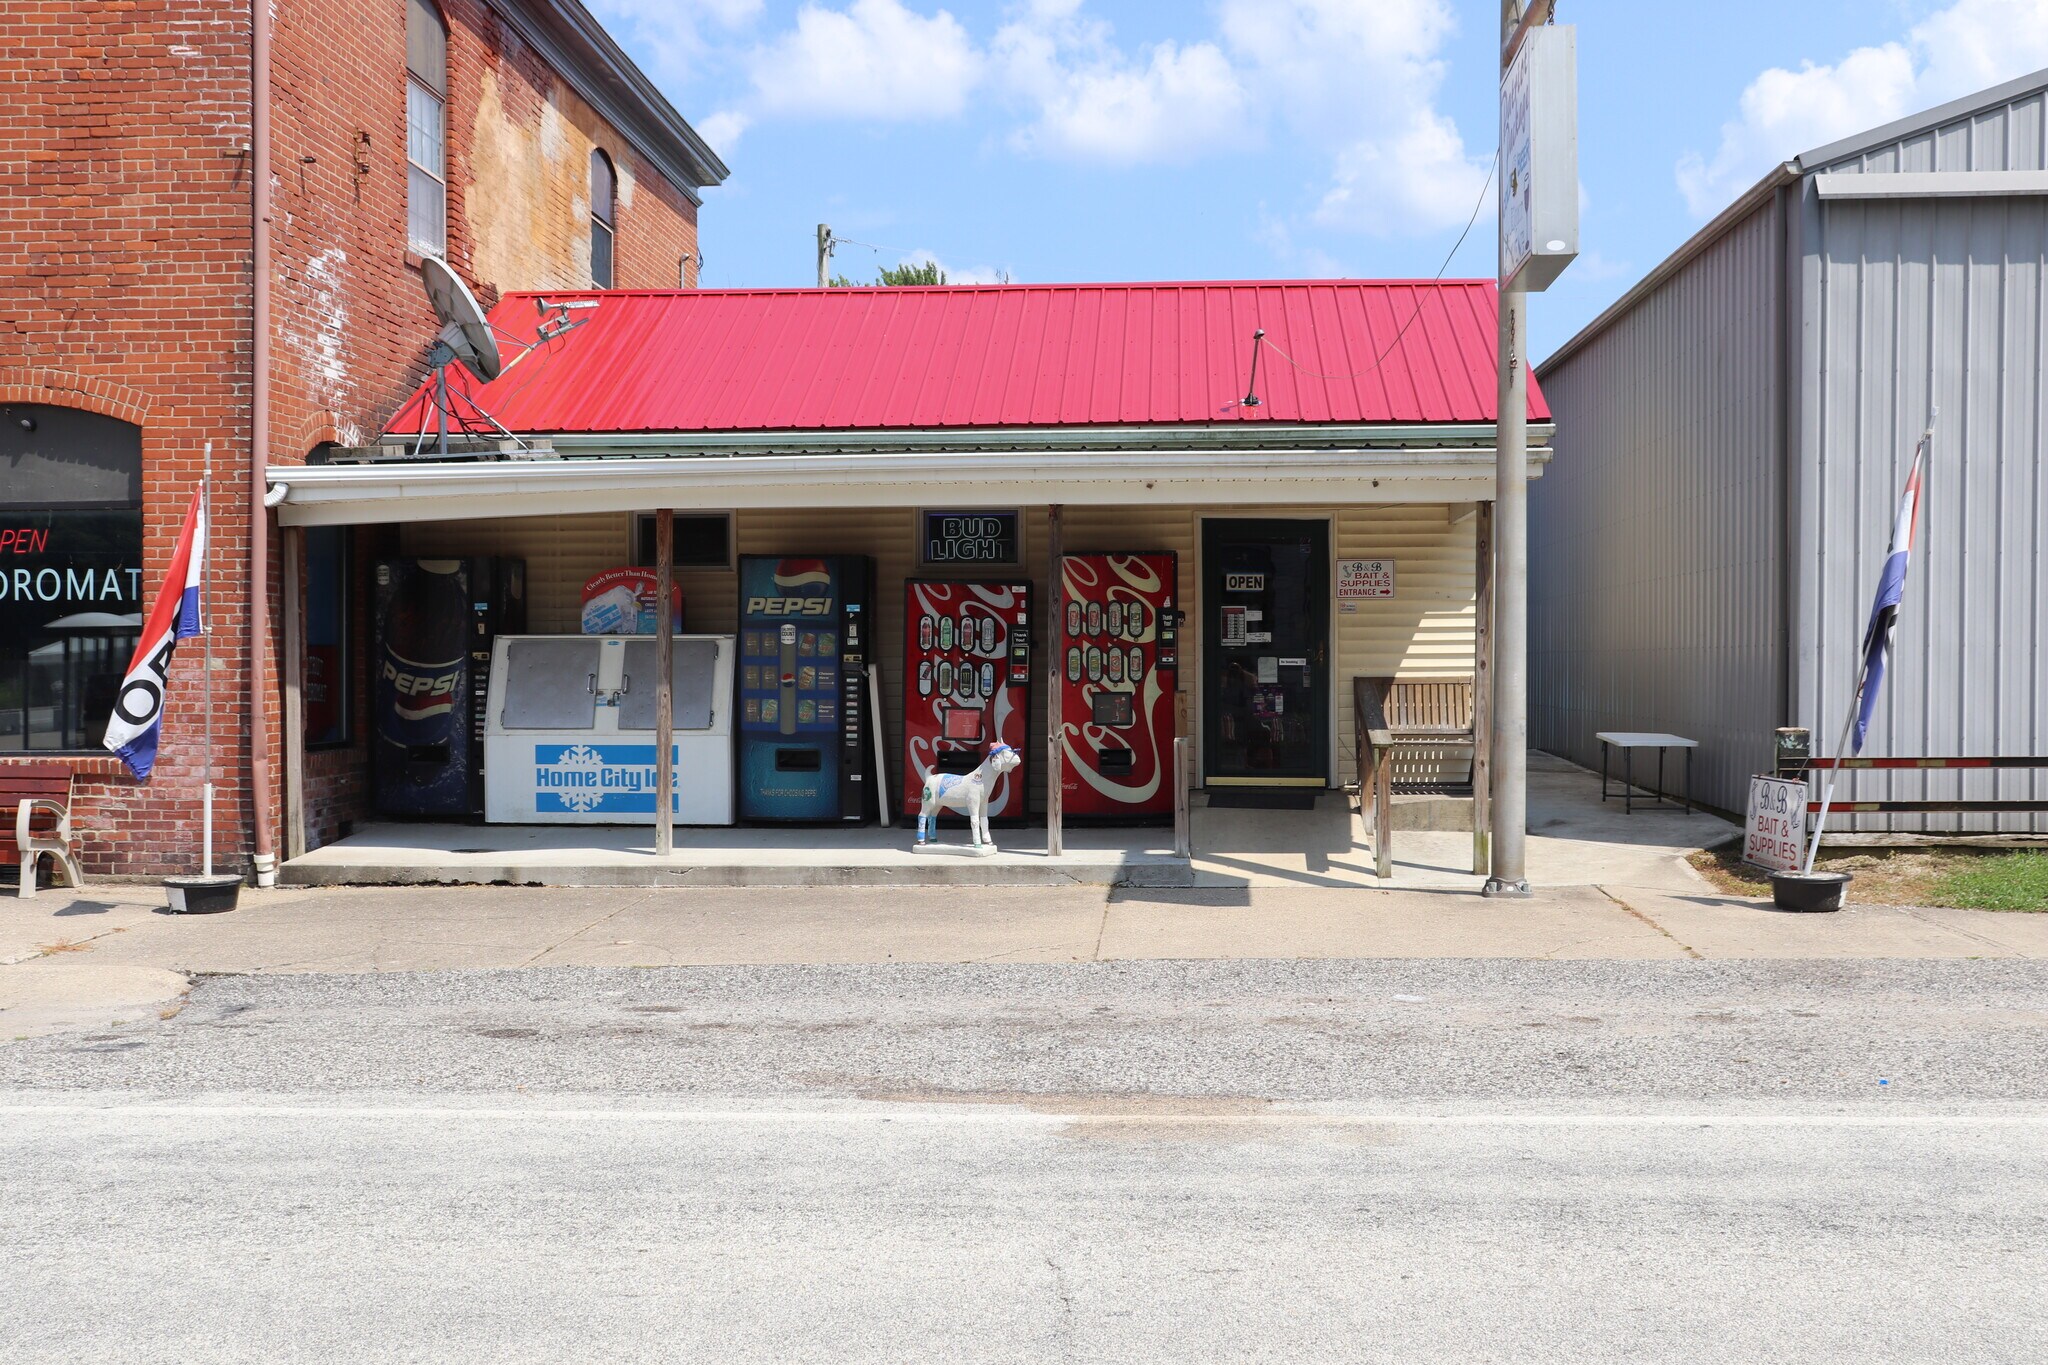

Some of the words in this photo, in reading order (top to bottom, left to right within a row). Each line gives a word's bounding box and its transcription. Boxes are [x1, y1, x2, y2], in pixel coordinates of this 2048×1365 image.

[943, 517, 1002, 538] BUD
[930, 538, 1012, 560] LIGHT
[586, 576, 606, 591] Clearly
[605, 572, 624, 580] Better
[1228, 576, 1263, 589] OPEN
[1382, 571, 1389, 579] &
[746, 597, 833, 616] PEPSI
[382, 660, 460, 697] PEPSI
[536, 768, 597, 788] Home
[601, 768, 642, 792] City
[1757, 815, 1779, 835] BAIT
[1780, 820, 1789, 838] &
[1749, 834, 1797, 861] SUPPLIES
